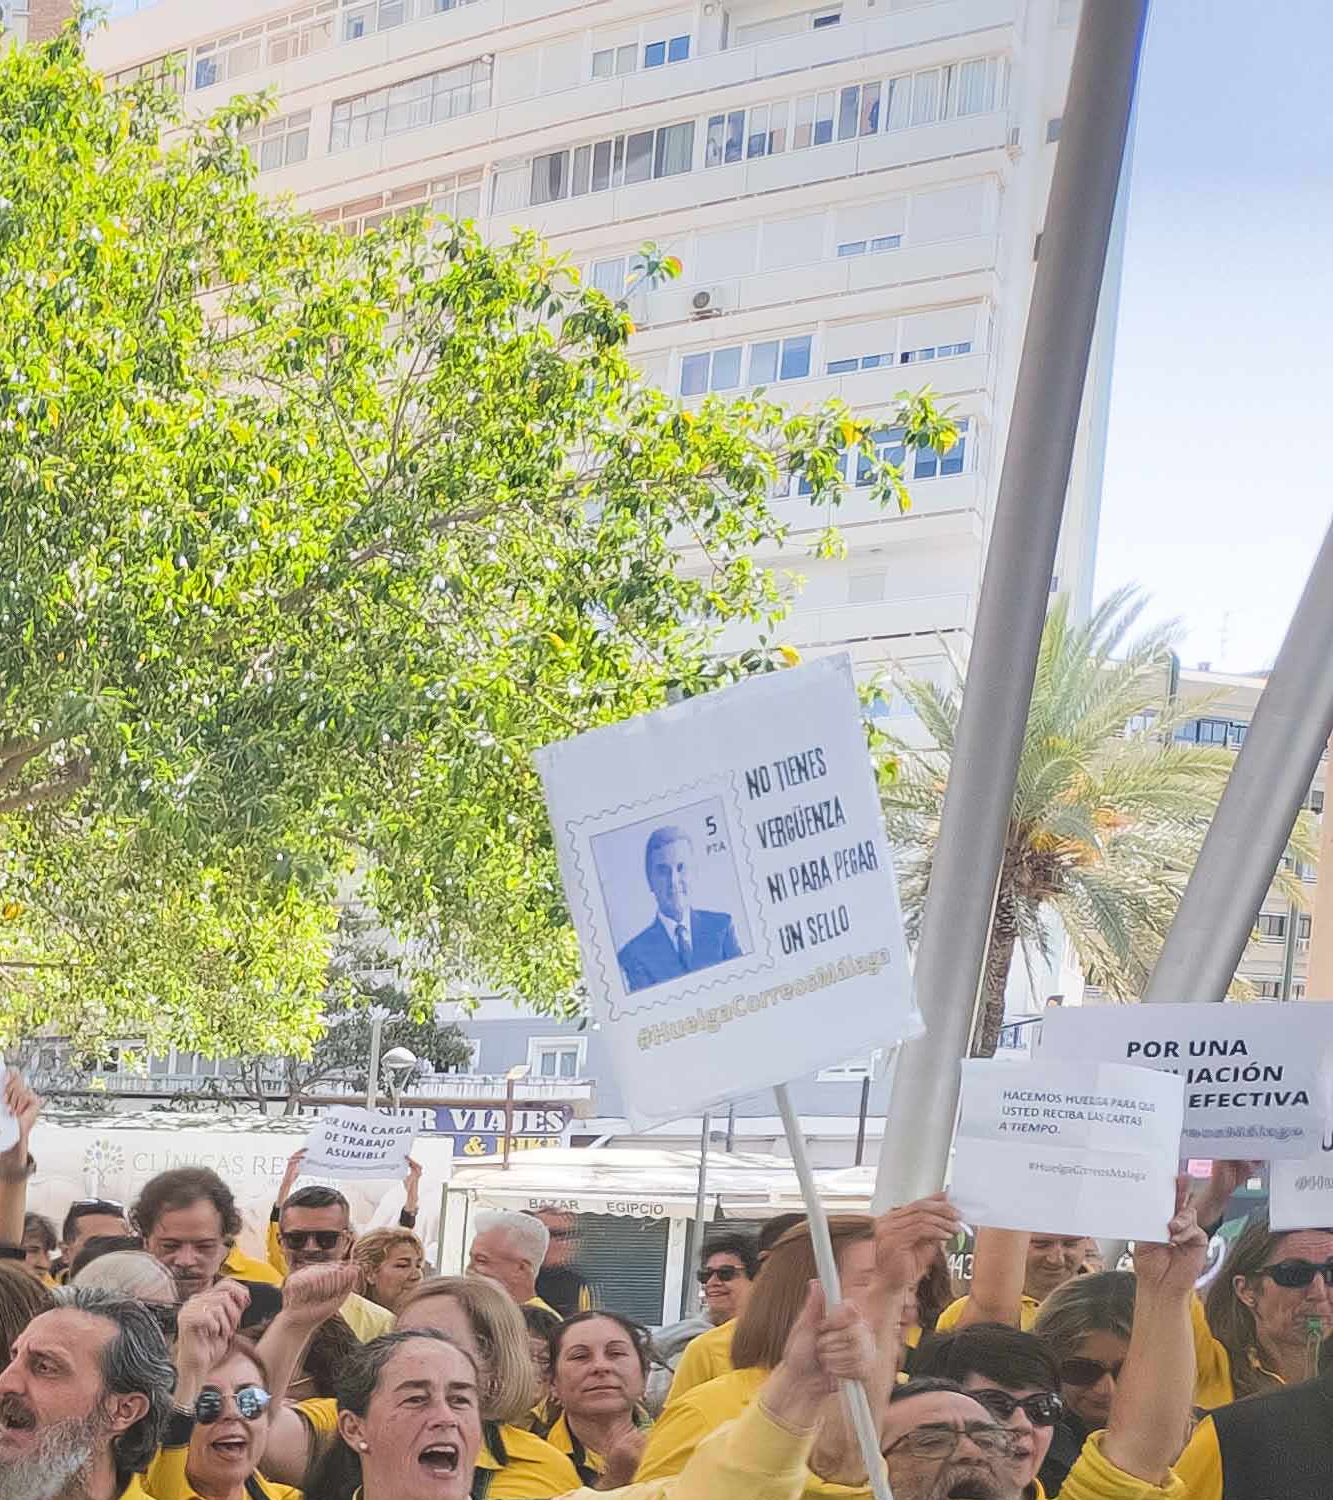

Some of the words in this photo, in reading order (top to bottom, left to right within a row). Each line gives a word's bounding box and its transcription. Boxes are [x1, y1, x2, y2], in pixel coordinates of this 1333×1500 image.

[745, 765, 771, 800] NO
[773, 747, 828, 792] TIENES
[706, 816, 717, 836] 5
[757, 796, 847, 849] VERGÜENZA
[706, 840, 727, 855] PTA
[766, 874, 787, 904] NI
[789, 855, 833, 897] PARA
[834, 840, 878, 881] PEGAR
[778, 924, 805, 956] UN
[807, 904, 850, 946] SELLO
[1126, 1041, 1180, 1058] POR
[1189, 1039, 1248, 1056] UNA
[1003, 1091, 1062, 1104] HACEMOS
[1065, 1095, 1108, 1106] HUELGA
[1111, 1098, 1136, 1109] PARA
[1188, 1090, 1310, 1108] EFECTIVA
[449, 1109, 566, 1133] VIAJES
[1002, 1106, 1039, 1118] USTED
[1043, 1109, 1084, 1120] RECIBA
[1088, 1112, 1104, 1122] LAS
[1107, 1113, 1142, 1126] CARTAS
[341, 1120, 367, 1134] UNA
[371, 1125, 413, 1136] CARGA
[998, 1122, 1007, 1131] A
[1011, 1122, 1061, 1135] TIEMPO.
[324, 1131, 340, 1143] DE
[341, 1135, 396, 1149] TRABAJO
[464, 1136, 487, 1156] &
[133, 1148, 245, 1175] CLÍNICAS
[325, 1147, 387, 1160] ASUMIBLE
[529, 1199, 580, 1210] BAZAR
[606, 1202, 664, 1215] EGIPCIO
